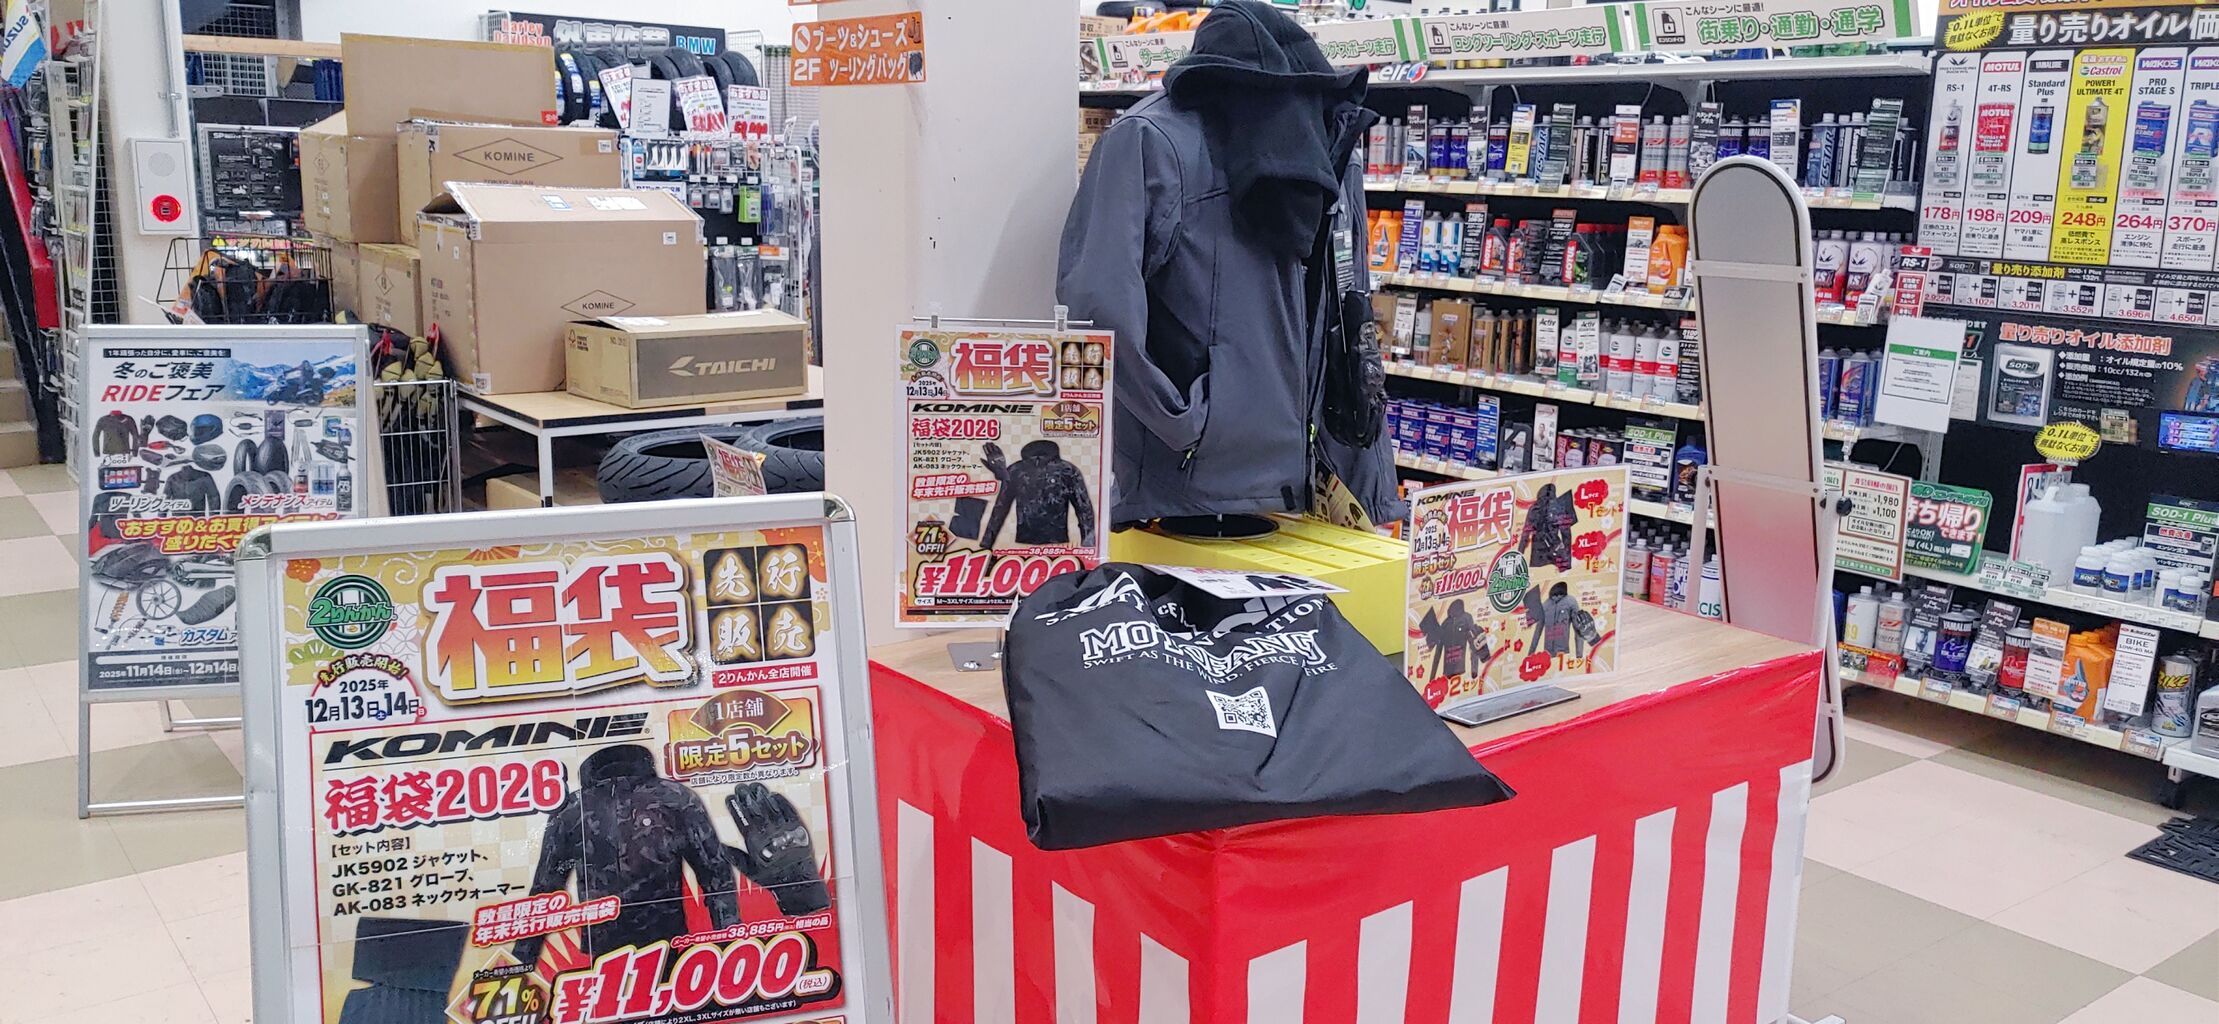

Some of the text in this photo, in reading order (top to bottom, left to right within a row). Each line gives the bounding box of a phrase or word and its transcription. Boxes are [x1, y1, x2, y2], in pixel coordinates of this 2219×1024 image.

[501, 19, 544, 34] Harley
[1697, 5, 1884, 44] 街乗り・通勤・通学
[494, 31, 551, 47] Davidson
[675, 35, 716, 55] BMW
[1452, 27, 1606, 52] ロングツーリング・スポーツ走行
[794, 53, 908, 81] 2F ツーリングバッグ
[1378, 64, 1409, 81] elf
[1984, 62, 2020, 71] MOTUL
[2089, 66, 2122, 76] Castrol
[1946, 84, 1965, 92] RS-1
[1988, 84, 2012, 92] 4T-RS
[2028, 80, 2065, 88] Standard
[2138, 87, 2167, 95] STAGE
[2149, 78, 2167, 86] PRO
[2036, 88, 2055, 96] Plus
[484, 151, 535, 163] KOMINE
[1924, 207, 1960, 220] 178円
[1967, 208, 2004, 222] 198円
[2009, 210, 2051, 224] 209円
[2061, 212, 2106, 227] 248円
[2116, 214, 2163, 229] 264円
[2168, 216, 2216, 231] 370円
[2124, 233, 2150, 241] エンジン
[1901, 257, 1927, 268] RS-1
[582, 302, 615, 310] KOMINE
[2000, 323, 2172, 355] 量り売りオイル添加剤
[113, 361, 214, 379] 冬のご褒美
[695, 357, 776, 375] TAICHI
[955, 342, 1050, 391] 福袋
[101, 384, 225, 402] RIDEフェア
[912, 403, 1034, 413] KOMINE
[912, 417, 999, 439] 福袋2026
[1043, 416, 1096, 432] 限定5セット
[109, 497, 191, 511] ツーリングアイテム
[1417, 489, 1476, 506] KOMINE
[1448, 490, 1512, 546] 福袋
[2152, 507, 2189, 520] SOD-1
[2192, 513, 2219, 526] Plus
[916, 526, 946, 543] 71%
[716, 553, 801, 596] 先行
[308, 599, 397, 627] 2りんかん
[434, 562, 680, 691] 福袋
[717, 611, 807, 655] 販売
[2125, 638, 2149, 648] BIKE
[1084, 653, 1135, 669] SWIFT
[1139, 650, 1158, 660] AS
[1162, 653, 1194, 671] THE
[1245, 655, 1298, 672] FIERCE
[719, 666, 812, 684] 2りんかん全店開催
[340, 679, 388, 693] 2025年
[714, 698, 764, 720] 1店舗
[324, 713, 650, 764] KOMINE
[679, 729, 805, 770] 限定5セット
[324, 759, 562, 831] 福袋2026
[332, 837, 411, 858] 【セット内容】
[332, 858, 408, 878] JK5902
[332, 879, 403, 897] GK-821
[333, 884, 525, 917] AK-083 ネックウォーマー
[477, 895, 567, 926] 数量限定の
[475, 903, 618, 945] 年末先行販売福袋
[558, 938, 803, 1023] ¥11,000
[473, 977, 539, 1020] 71%
